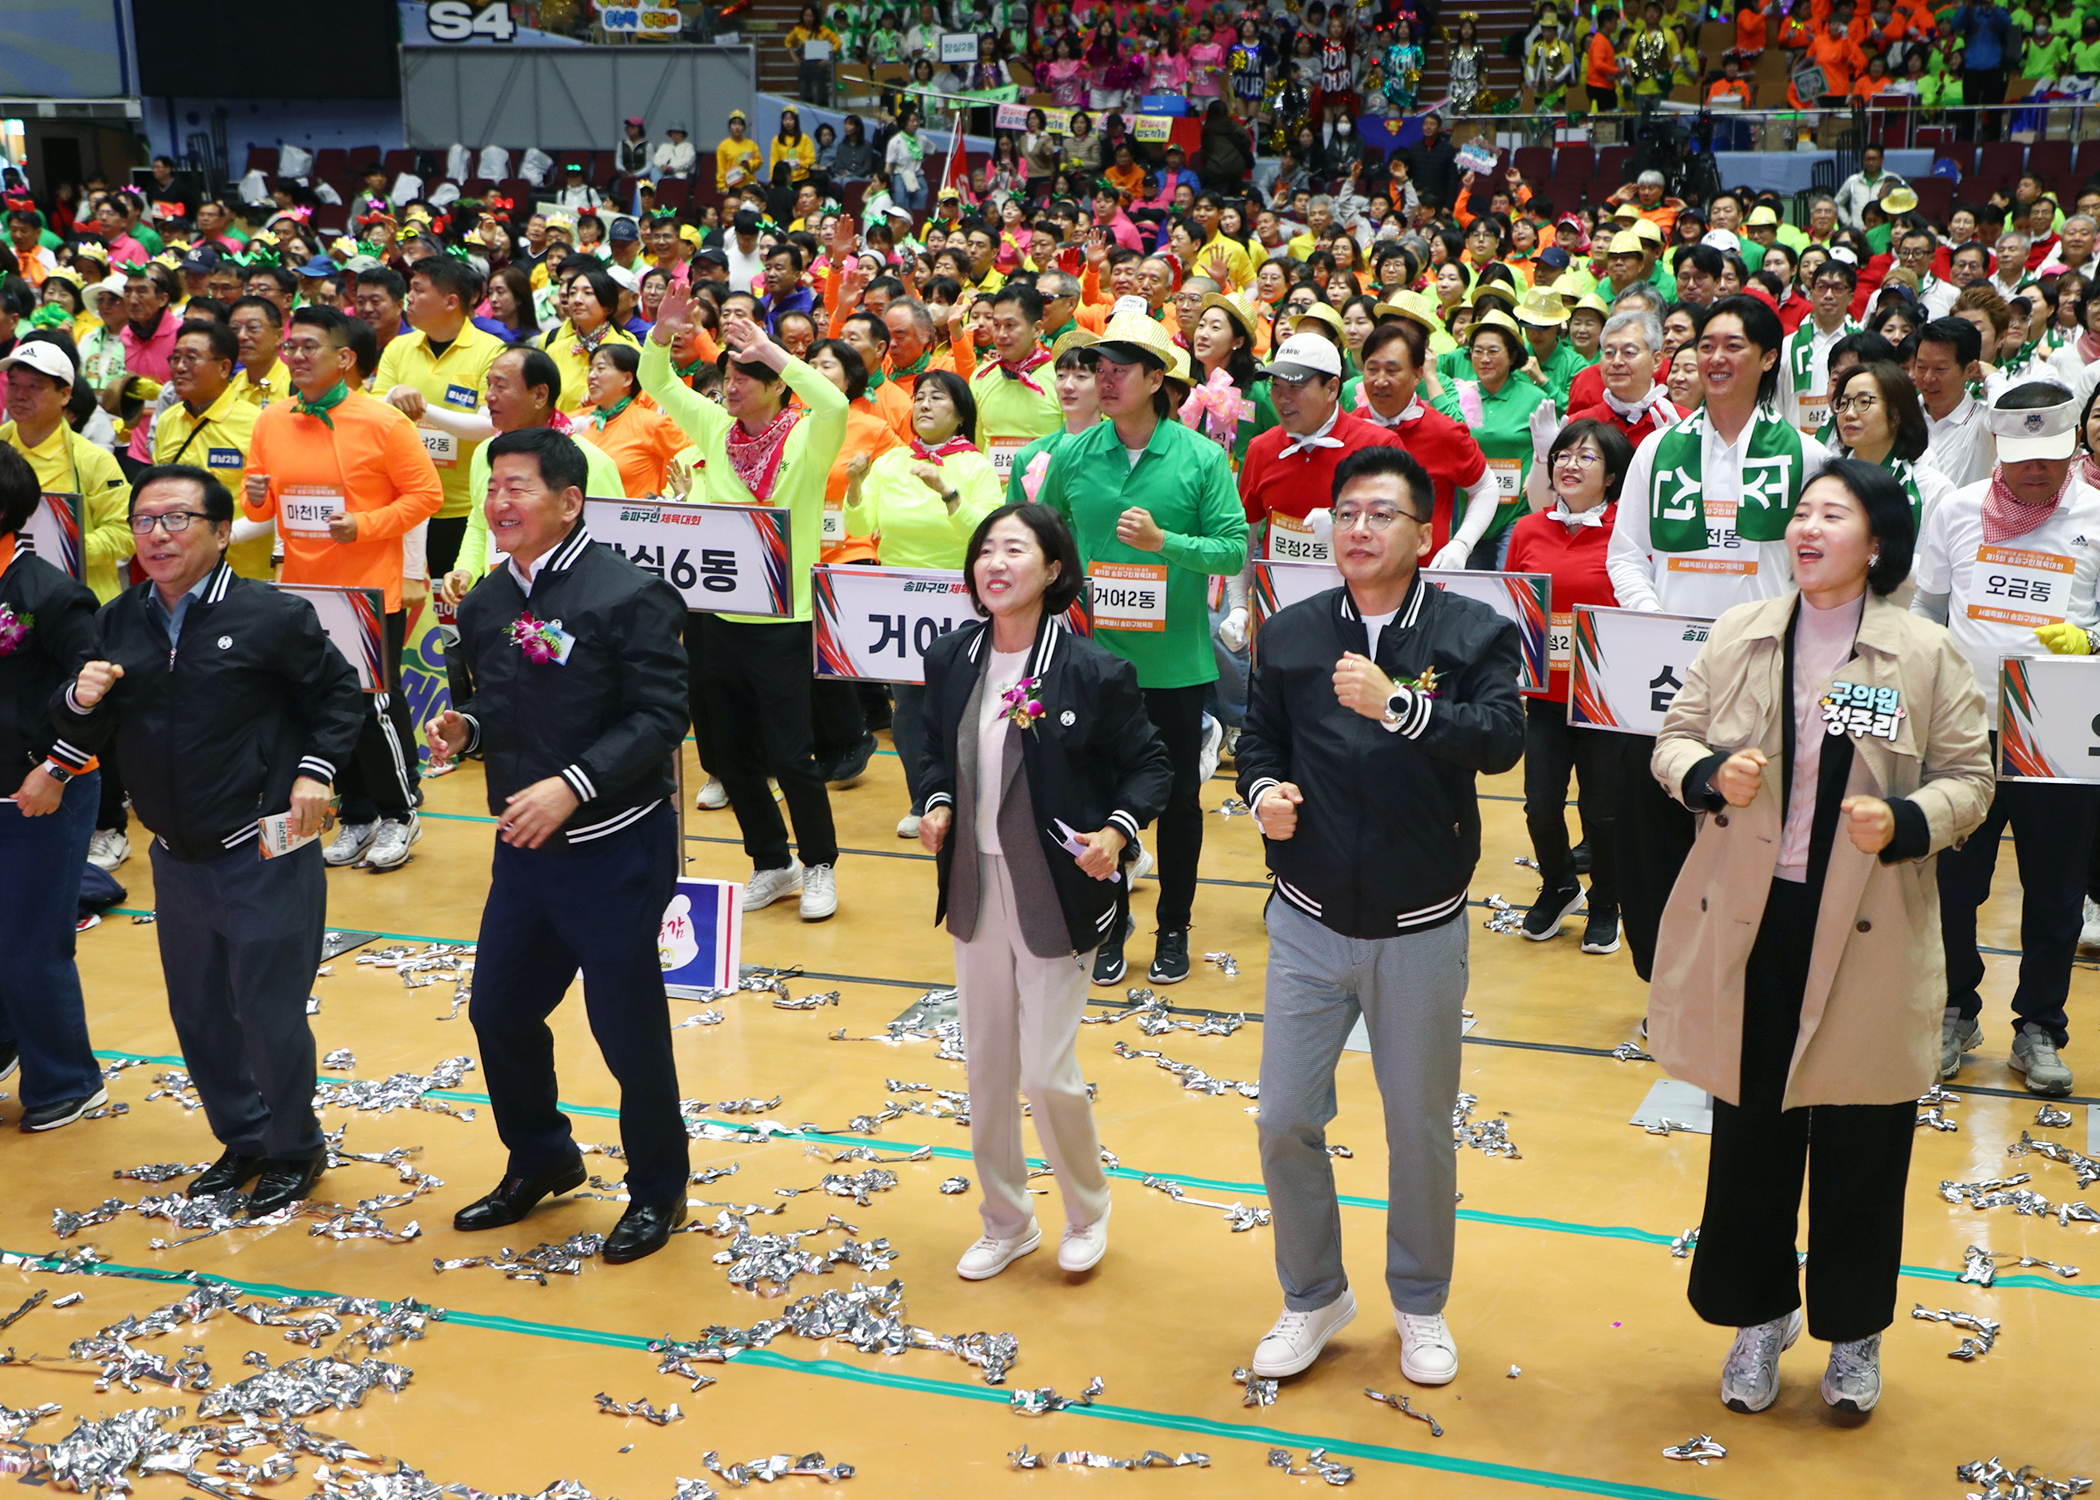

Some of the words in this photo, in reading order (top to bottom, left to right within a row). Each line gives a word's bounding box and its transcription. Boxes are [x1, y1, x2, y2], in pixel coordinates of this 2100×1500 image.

[427, 1, 515, 41] S4
[943, 43, 976, 54] 잠실2동
[287, 504, 334, 522] 마천1동
[1275, 535, 1329, 560] 문정2동
[598, 542, 738, 593] 실6동
[1094, 588, 1156, 609] 거여2동
[1985, 575, 2052, 603] 오금동
[868, 613, 981, 658] 거여
[1829, 681, 1900, 715] 구의원
[1821, 704, 1900, 742] 정주리
